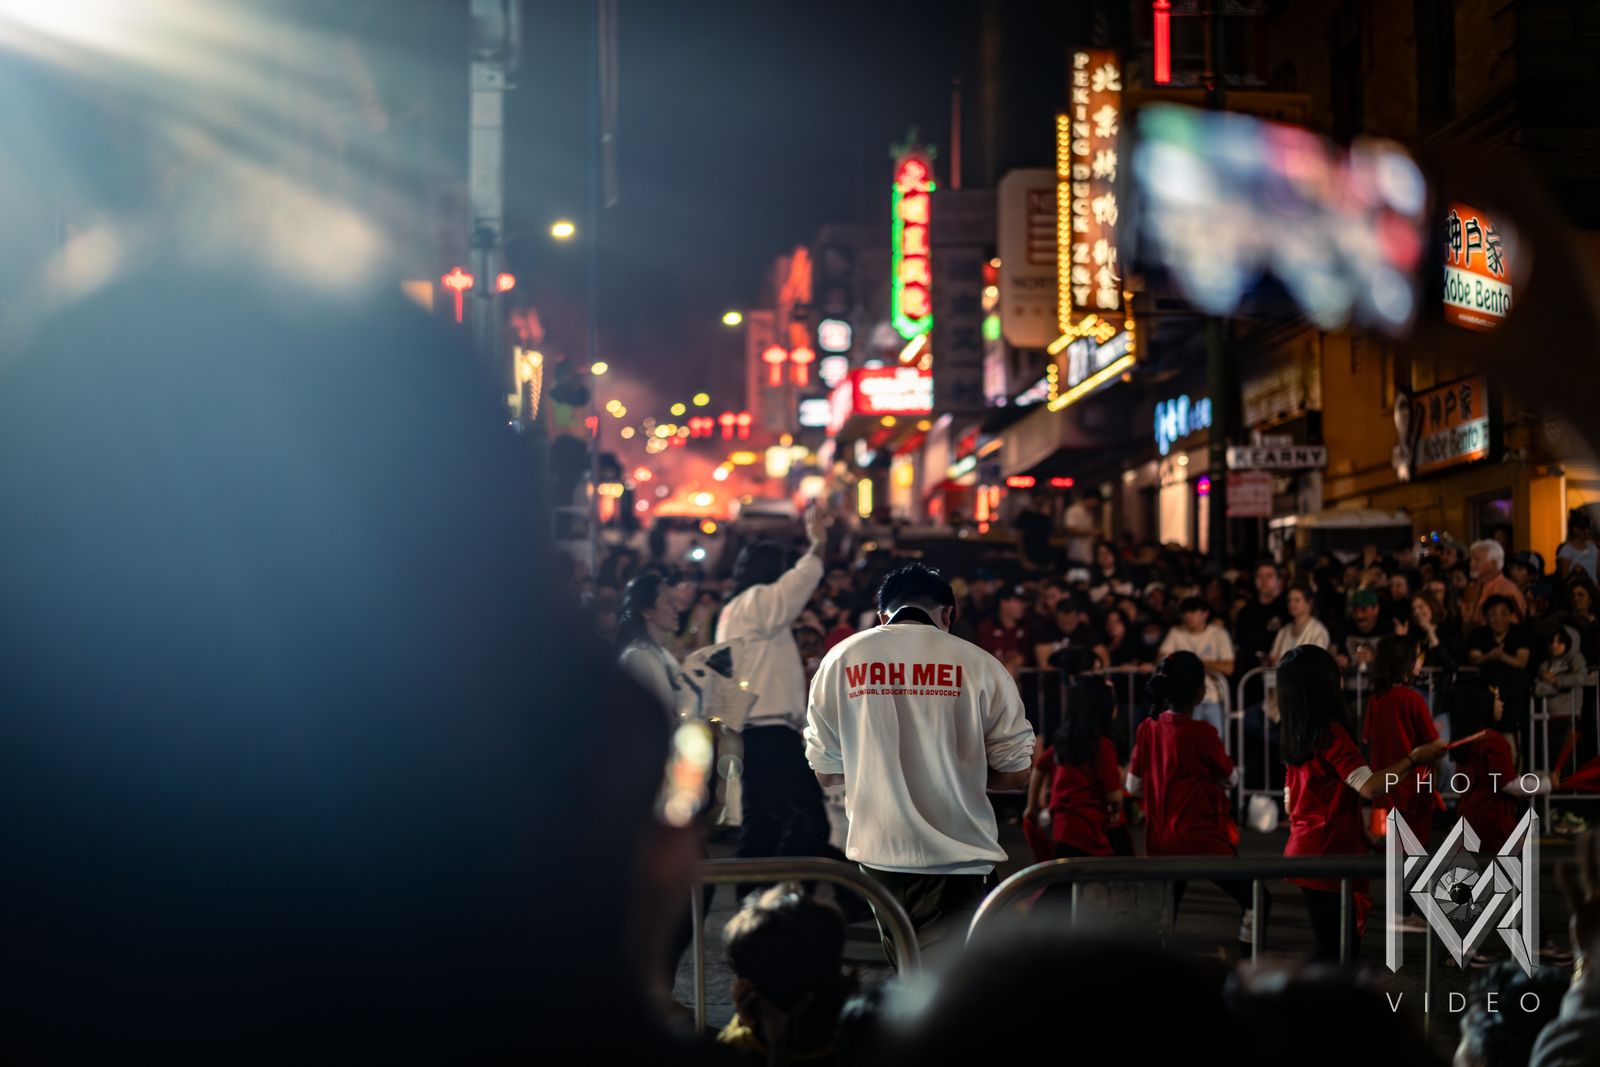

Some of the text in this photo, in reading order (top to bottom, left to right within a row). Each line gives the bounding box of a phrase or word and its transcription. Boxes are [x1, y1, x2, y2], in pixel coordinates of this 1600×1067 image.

[1072, 52, 1090, 156] PEKING
[1072, 163, 1091, 233] DUCK
[1443, 269, 1511, 314] Kobe Bento
[1235, 450, 1322, 463] KEARNY
[845, 662, 962, 688] WAH MEI
[881, 688, 918, 696] EDUCATION
[925, 689, 961, 698] ADVOCACY
